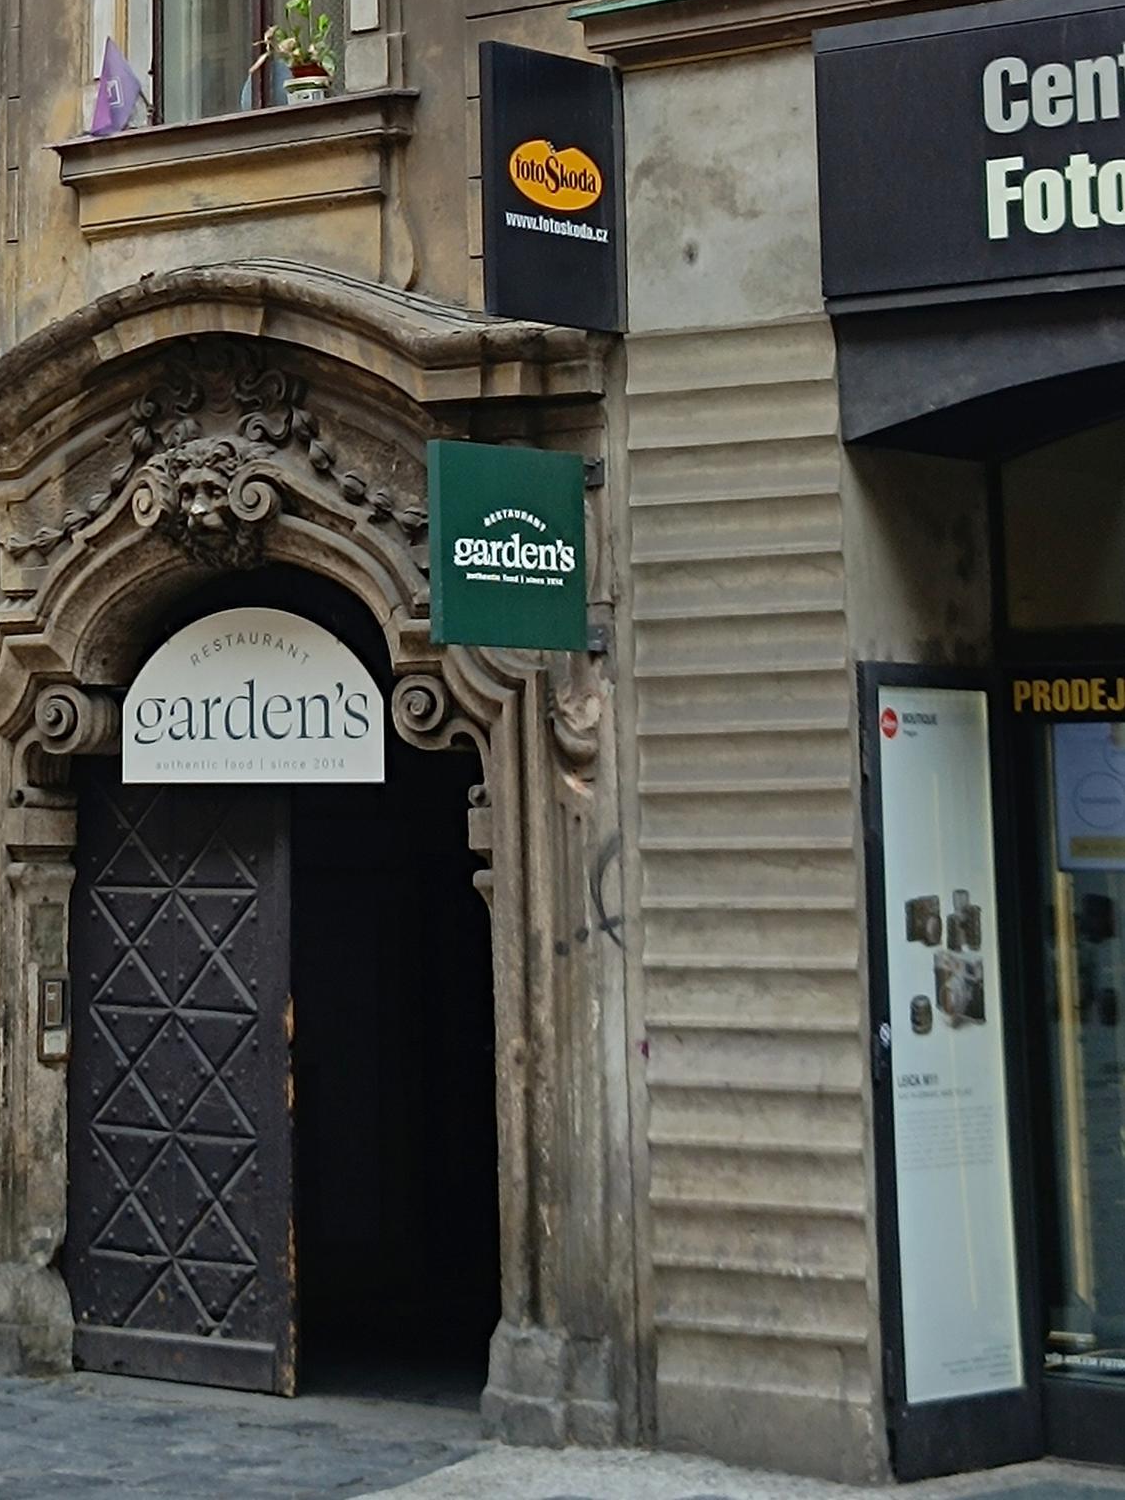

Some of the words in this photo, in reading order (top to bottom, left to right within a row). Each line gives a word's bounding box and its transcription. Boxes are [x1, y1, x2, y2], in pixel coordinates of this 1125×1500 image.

[982, 41, 1125, 134] Cen
[505, 211, 609, 244] www.fotoskoda.cz
[483, 509, 547, 532] RESTAURANT
[453, 533, 576, 572] garden's
[190, 632, 311, 667] RESTAURANT
[133, 679, 370, 745] garden's
[156, 758, 219, 770] authentic
[224, 758, 253, 770] food
[271, 757, 306, 770] since
[313, 757, 346, 770] 2014
